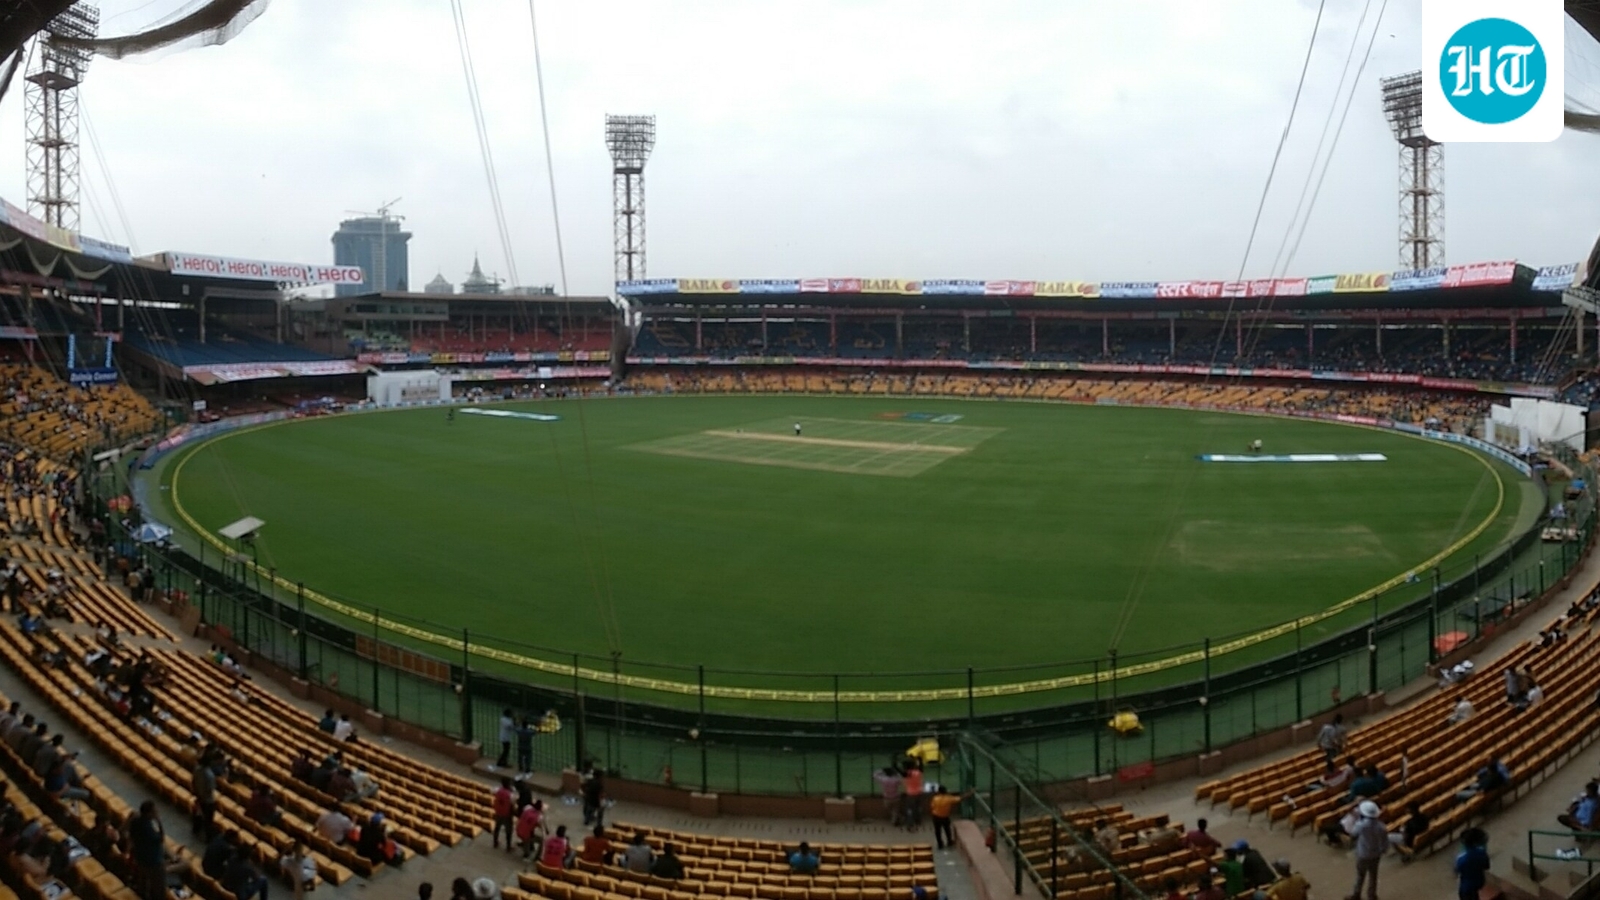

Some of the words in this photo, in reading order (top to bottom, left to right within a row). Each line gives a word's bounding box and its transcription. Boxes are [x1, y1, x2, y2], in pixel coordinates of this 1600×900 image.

[183, 257, 216, 272] Hero
[227, 262, 259, 276] Hero
[270, 265, 301, 279] Hero
[317, 267, 361, 282] Hero
